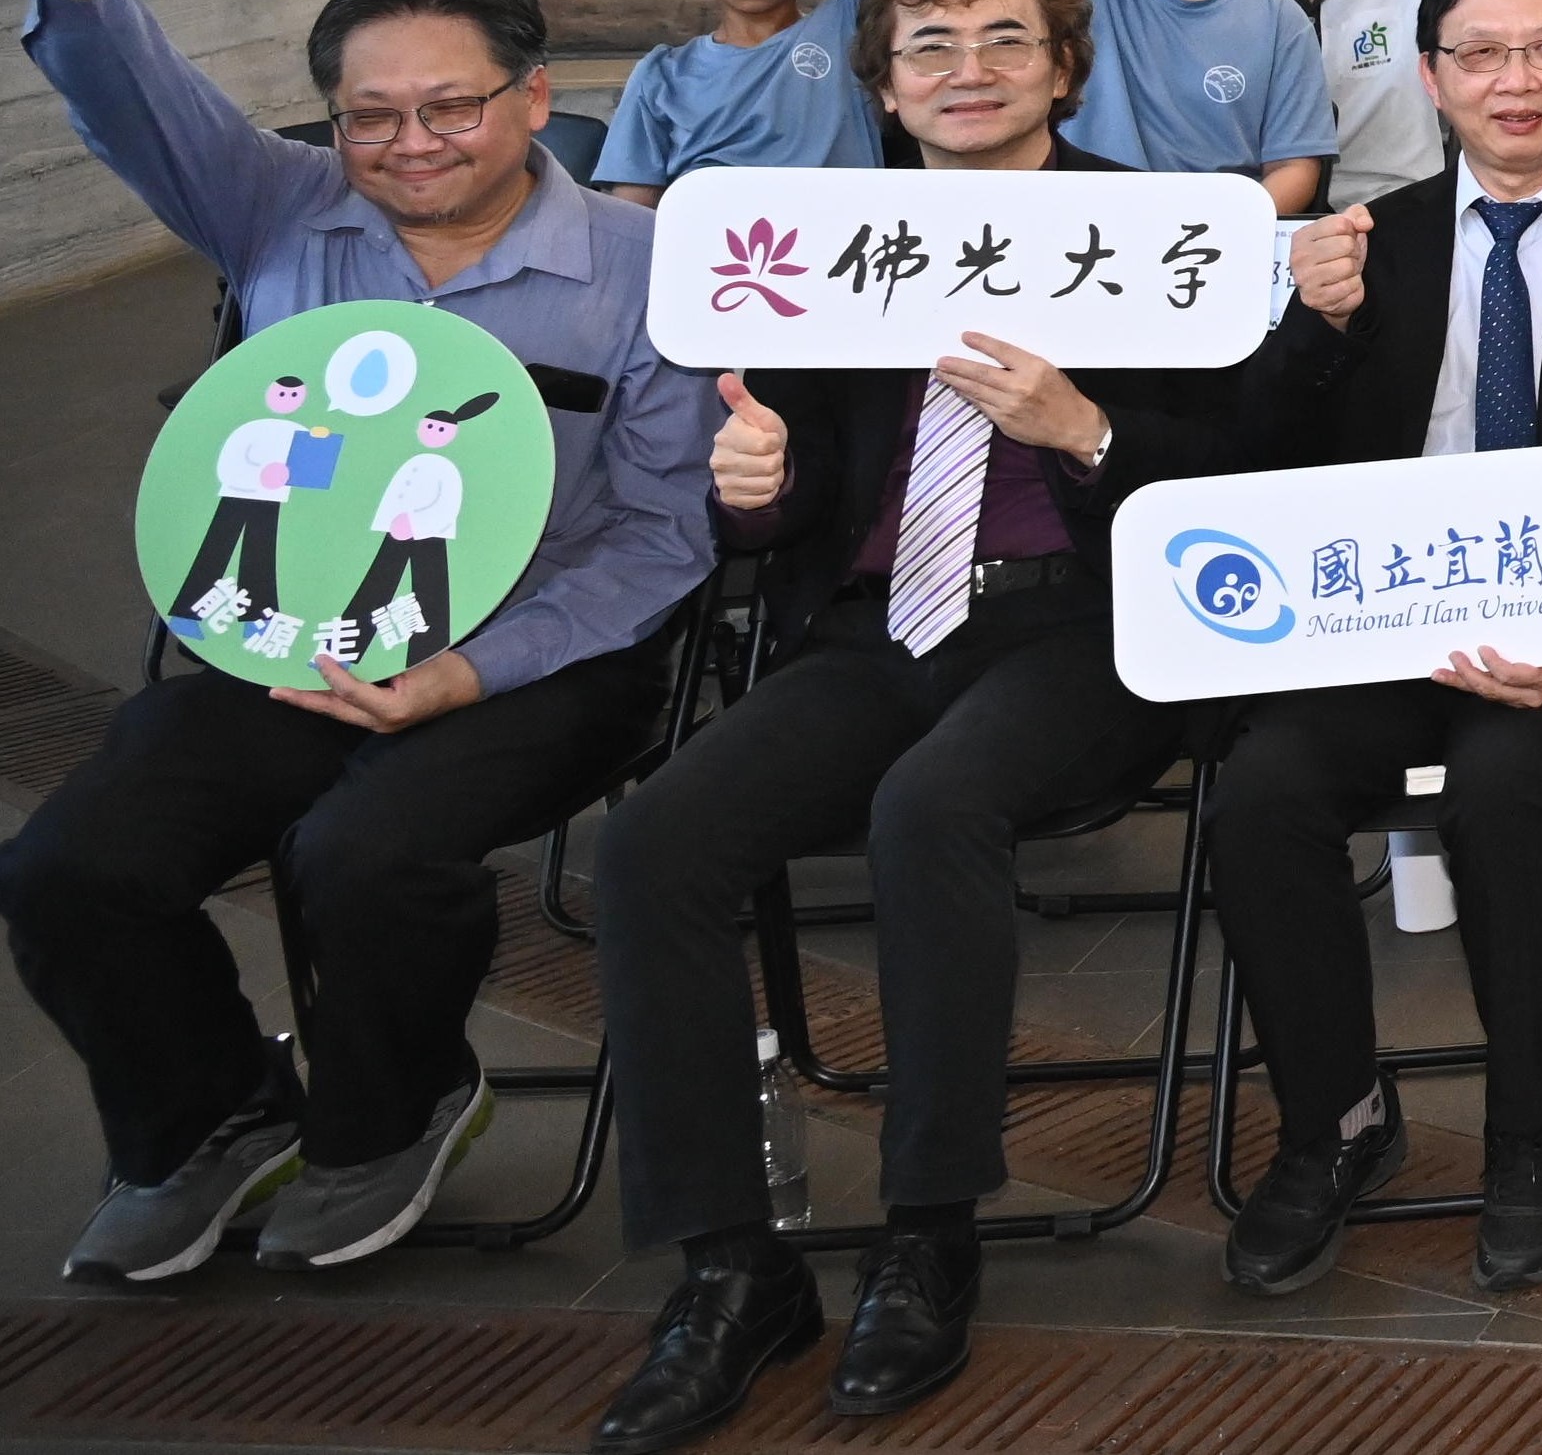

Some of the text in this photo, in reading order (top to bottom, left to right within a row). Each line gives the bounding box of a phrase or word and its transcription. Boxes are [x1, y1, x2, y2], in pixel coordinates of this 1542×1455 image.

[190, 576, 431, 659] 能源走讀
[1306, 602, 1418, 638] National
[1420, 601, 1469, 626] Ilan
